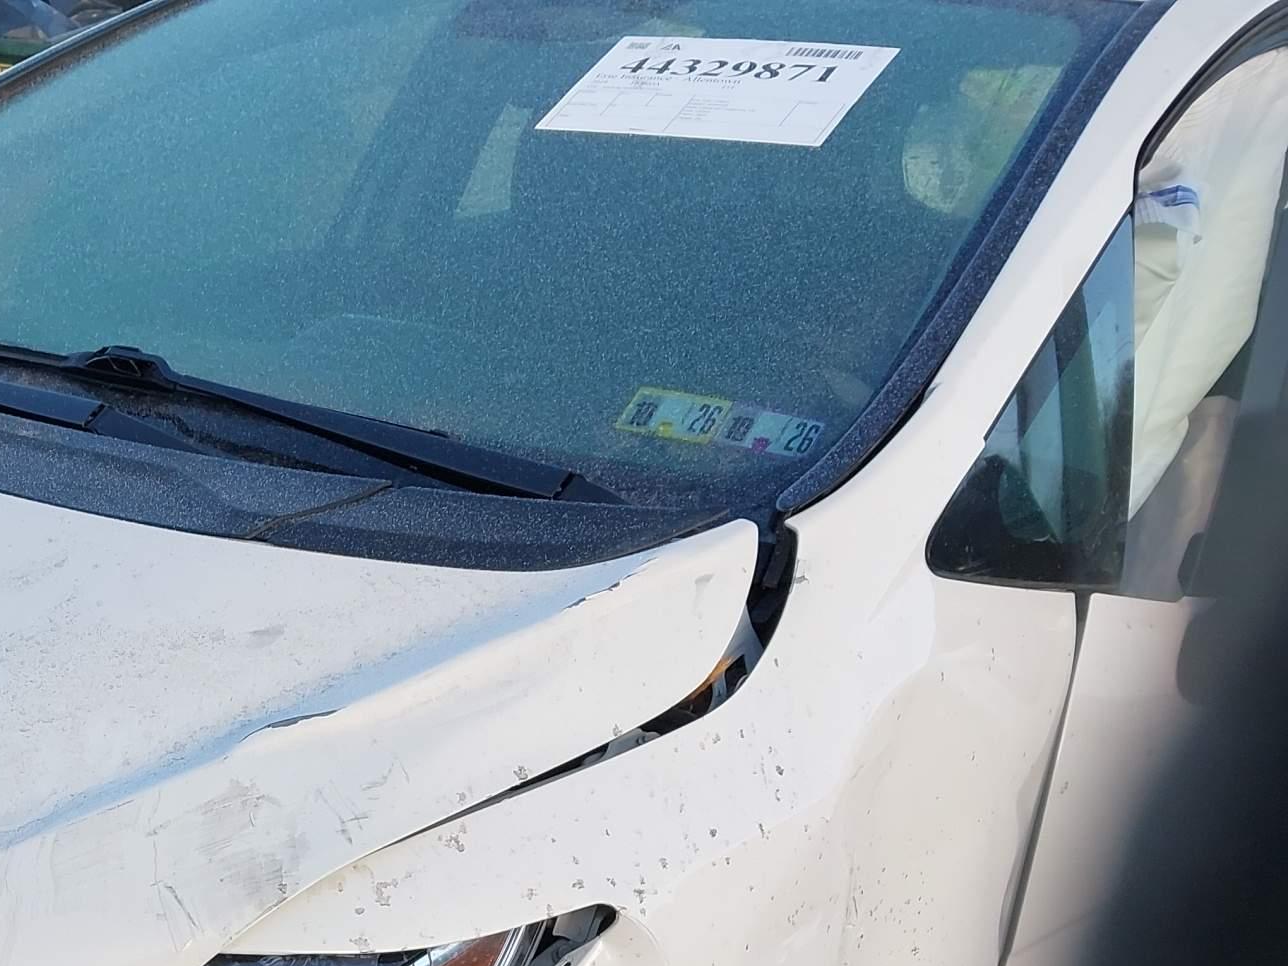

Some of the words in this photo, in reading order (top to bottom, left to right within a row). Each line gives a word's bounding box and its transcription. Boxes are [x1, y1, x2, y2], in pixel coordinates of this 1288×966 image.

[620, 56, 839, 83] 44329871
[688, 402, 723, 435] 26
[784, 421, 820, 454] 26
